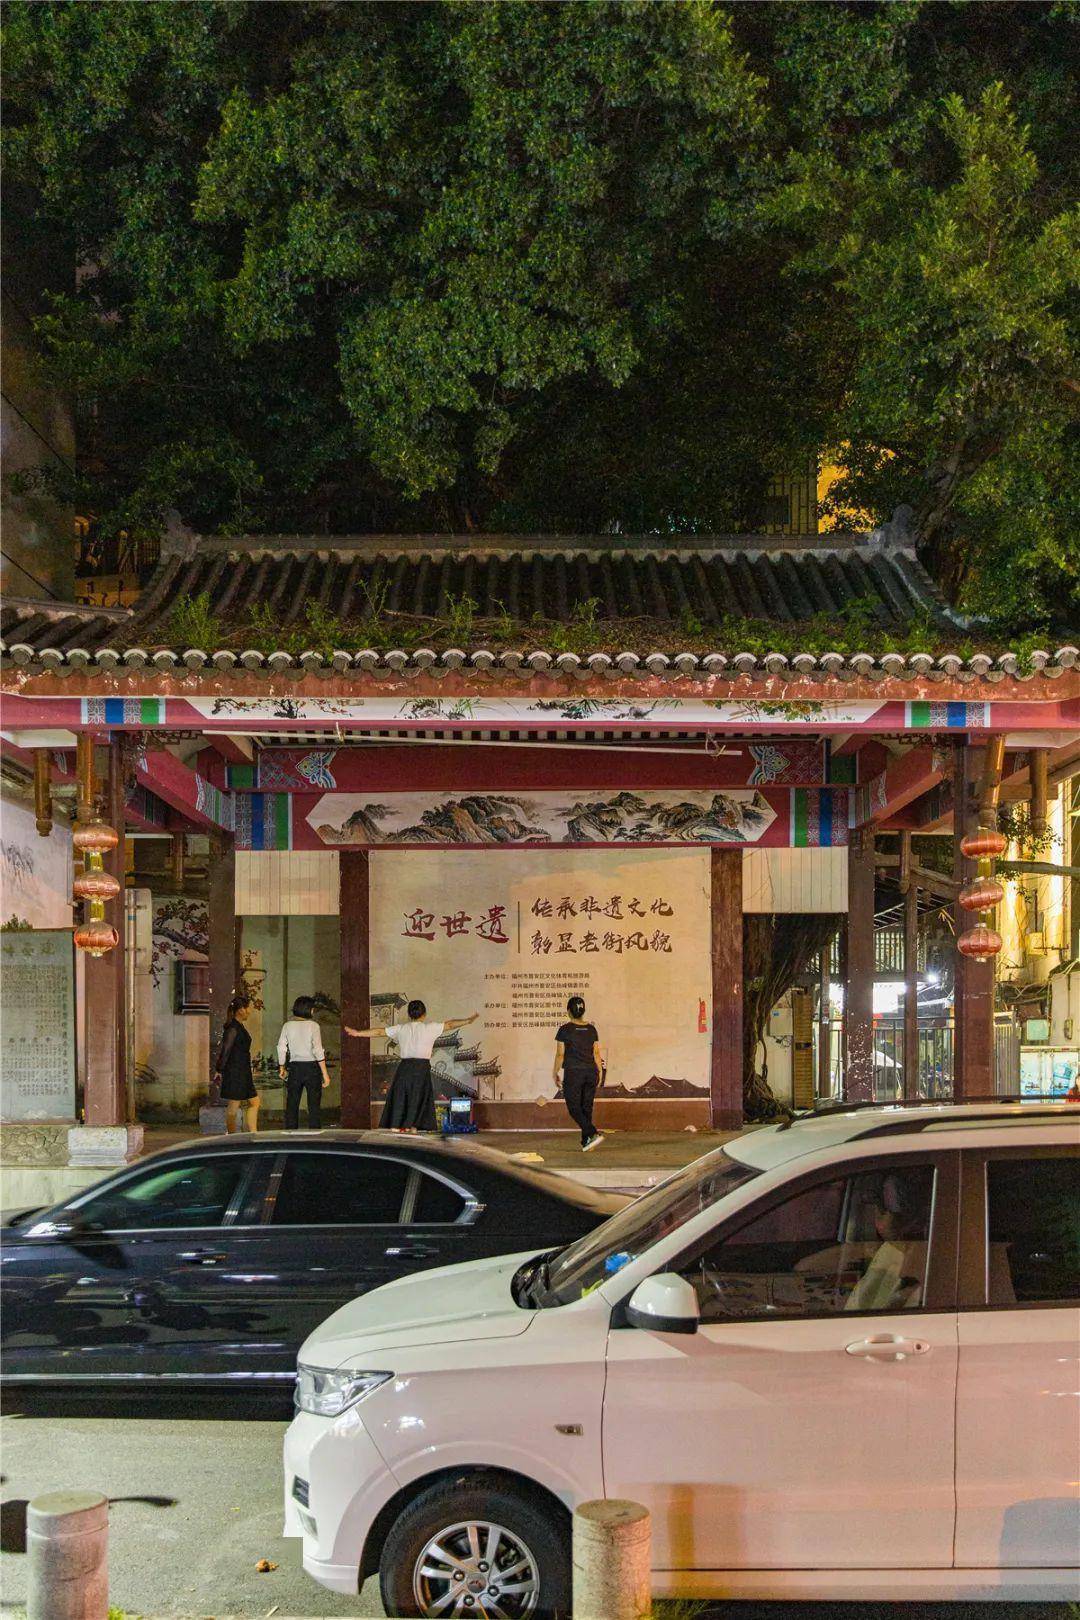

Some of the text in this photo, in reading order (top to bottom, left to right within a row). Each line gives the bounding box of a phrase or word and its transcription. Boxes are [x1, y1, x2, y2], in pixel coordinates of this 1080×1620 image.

[531, 895, 674, 920] 传承非遗文化
[401, 904, 510, 944] 迎世遗
[530, 929, 673, 955] 彰显老街风貌
